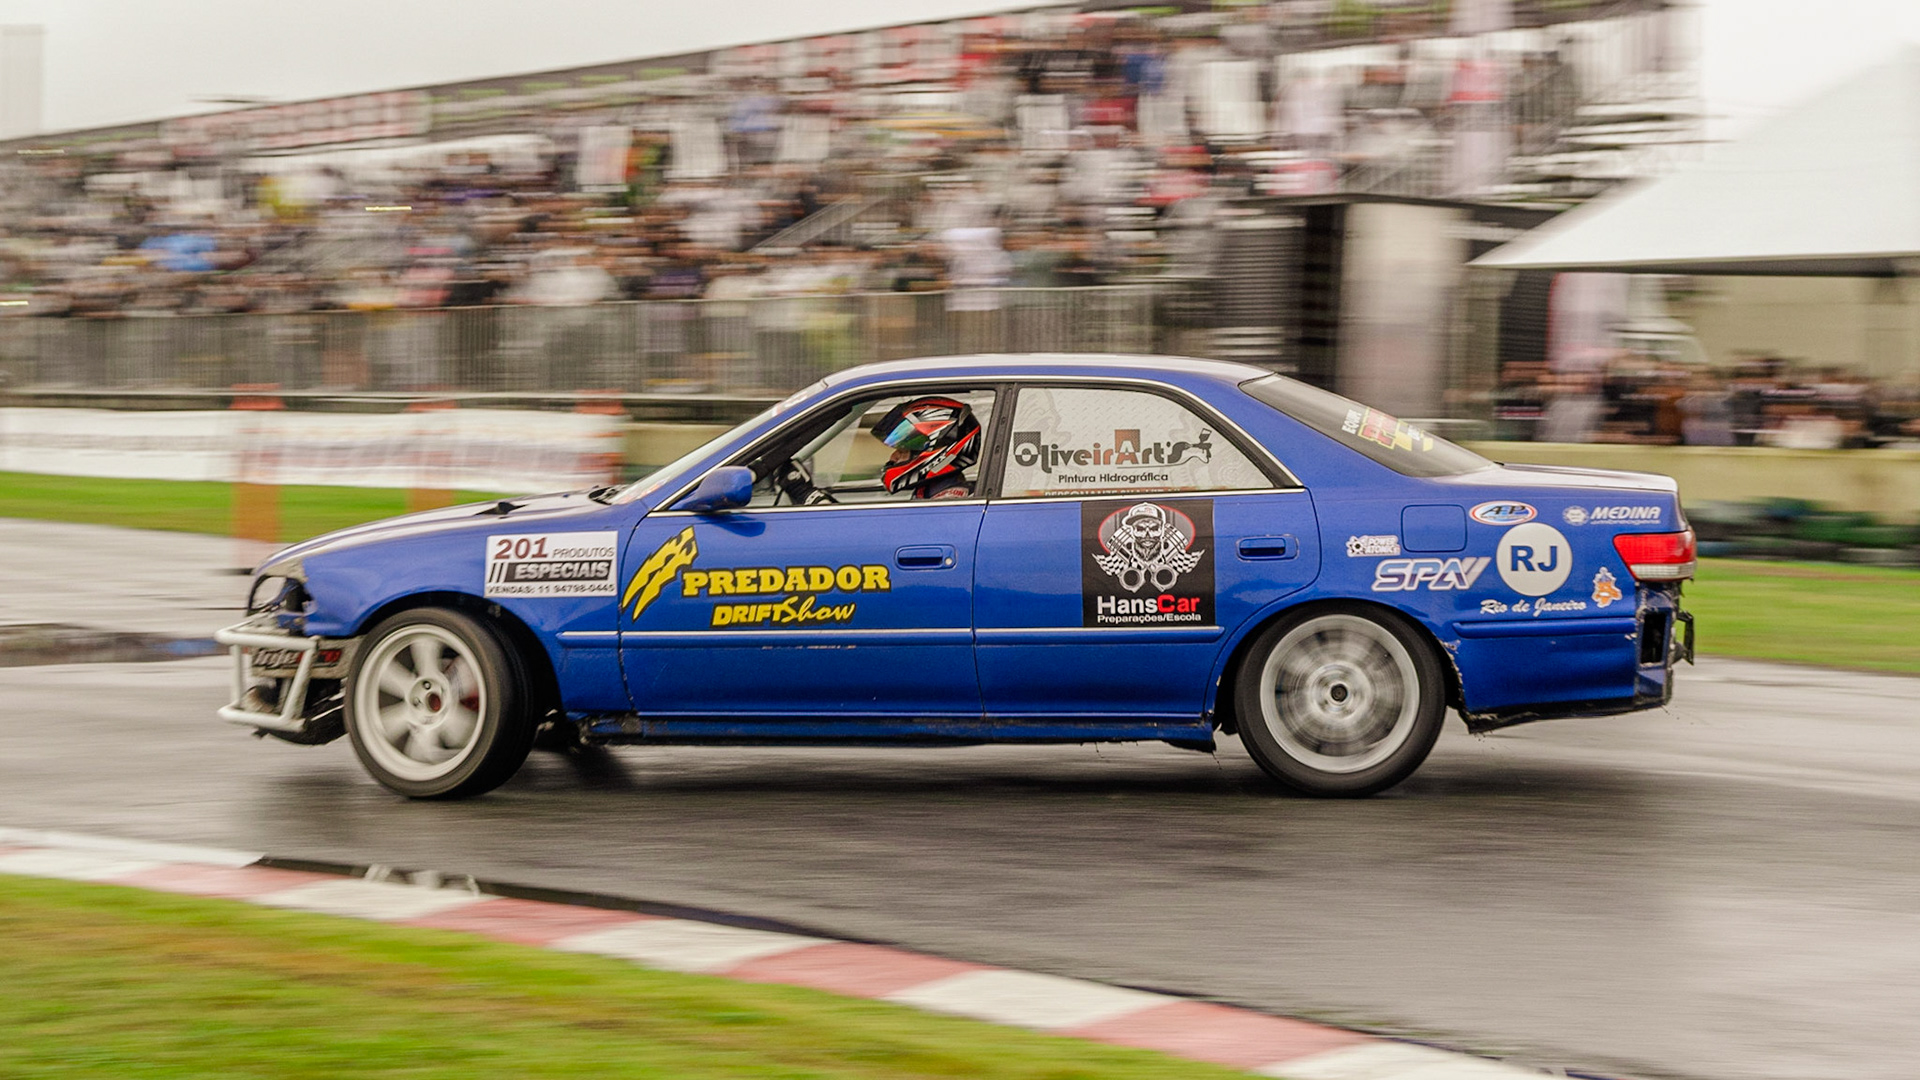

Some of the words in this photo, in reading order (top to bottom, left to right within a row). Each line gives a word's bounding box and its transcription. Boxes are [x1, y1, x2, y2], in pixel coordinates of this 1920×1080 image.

[1058, 474, 1096, 484] Pintura
[1099, 472, 1169, 484] Hidrográfica
[1590, 506, 1661, 520] MEDINA
[494, 537, 549, 560] 201
[552, 547, 615, 559] PRODUTOS
[1511, 545, 1557, 572] RJ
[514, 562, 610, 580] ESPECIAIS
[538, 585, 550, 593] 11
[682, 565, 890, 597] PREDADOR
[1097, 594, 1201, 614] HansCar
[1480, 600, 1508, 615] Rio
[1512, 600, 1531, 613] de
[1533, 598, 1587, 617] Janeiro
[1097, 613, 1202, 625] Preparações/Escola
